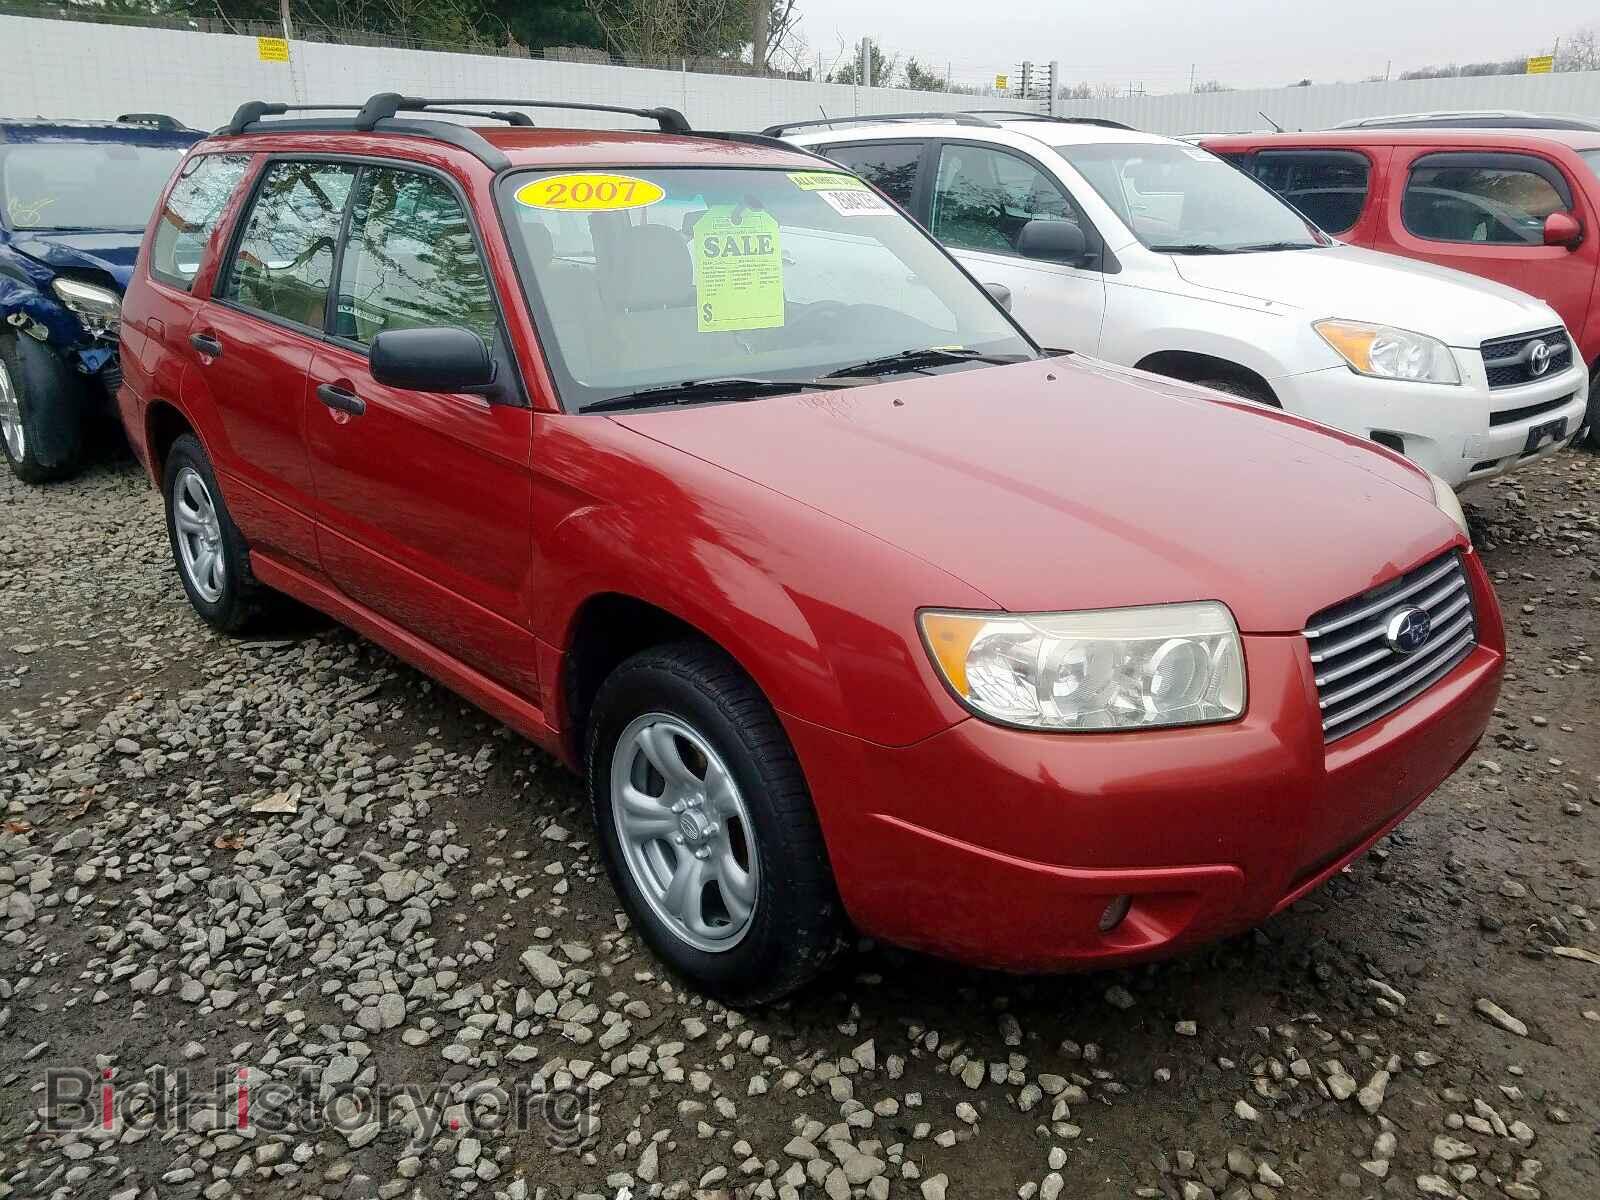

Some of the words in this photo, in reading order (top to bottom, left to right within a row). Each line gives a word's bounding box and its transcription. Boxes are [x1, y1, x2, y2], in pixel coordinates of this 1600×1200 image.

[545, 180, 637, 206] 2007
[703, 234, 775, 258] SALE
[702, 302, 713, 323] $
